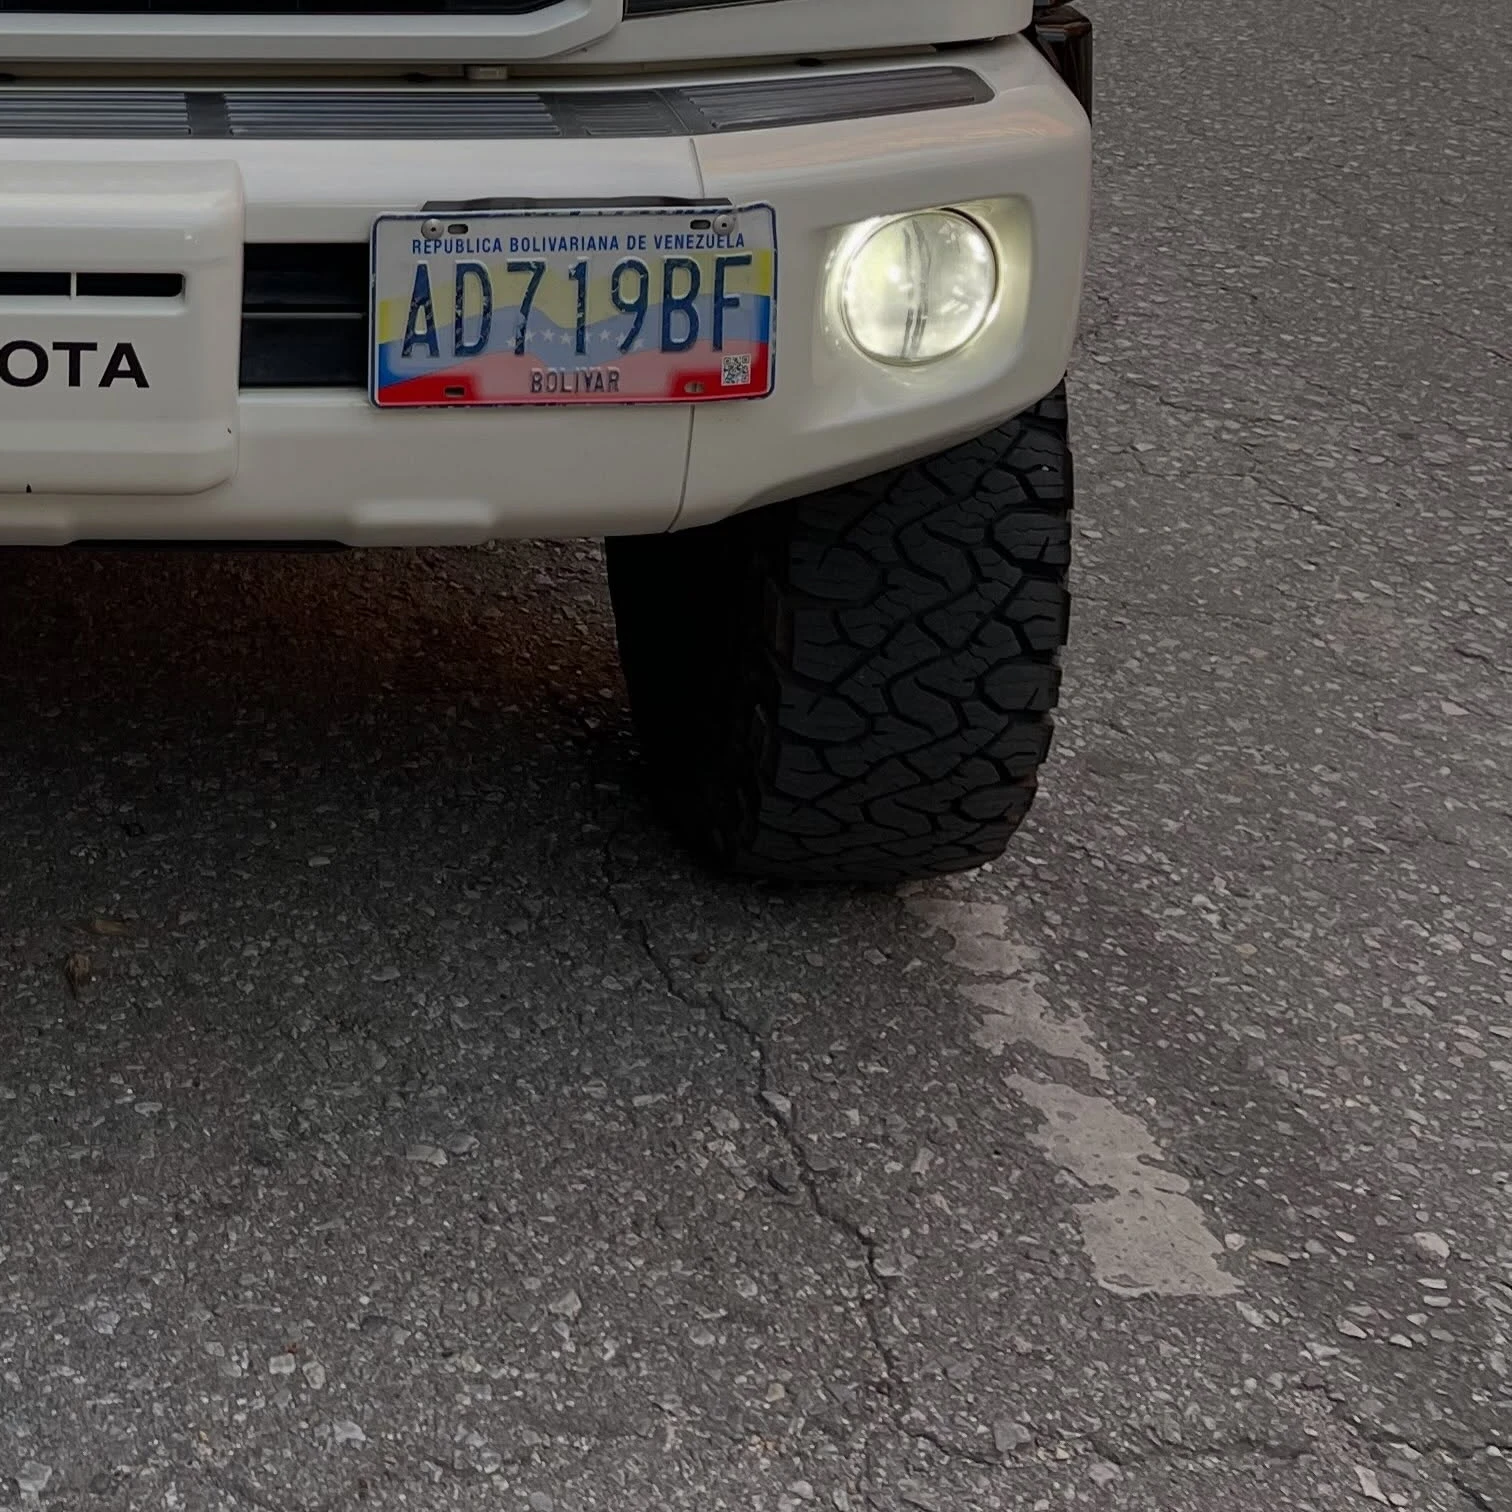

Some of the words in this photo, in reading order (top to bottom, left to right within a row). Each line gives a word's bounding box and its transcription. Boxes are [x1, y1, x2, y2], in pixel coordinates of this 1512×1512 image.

[411, 238, 503, 255] REPUBLICA
[509, 234, 620, 253] BOLIVARIANA
[626, 234, 647, 250] DE
[653, 232, 745, 250] VENEZUELA
[400, 254, 753, 359] AD719BF
[530, 367, 620, 394] BOLIVAR
